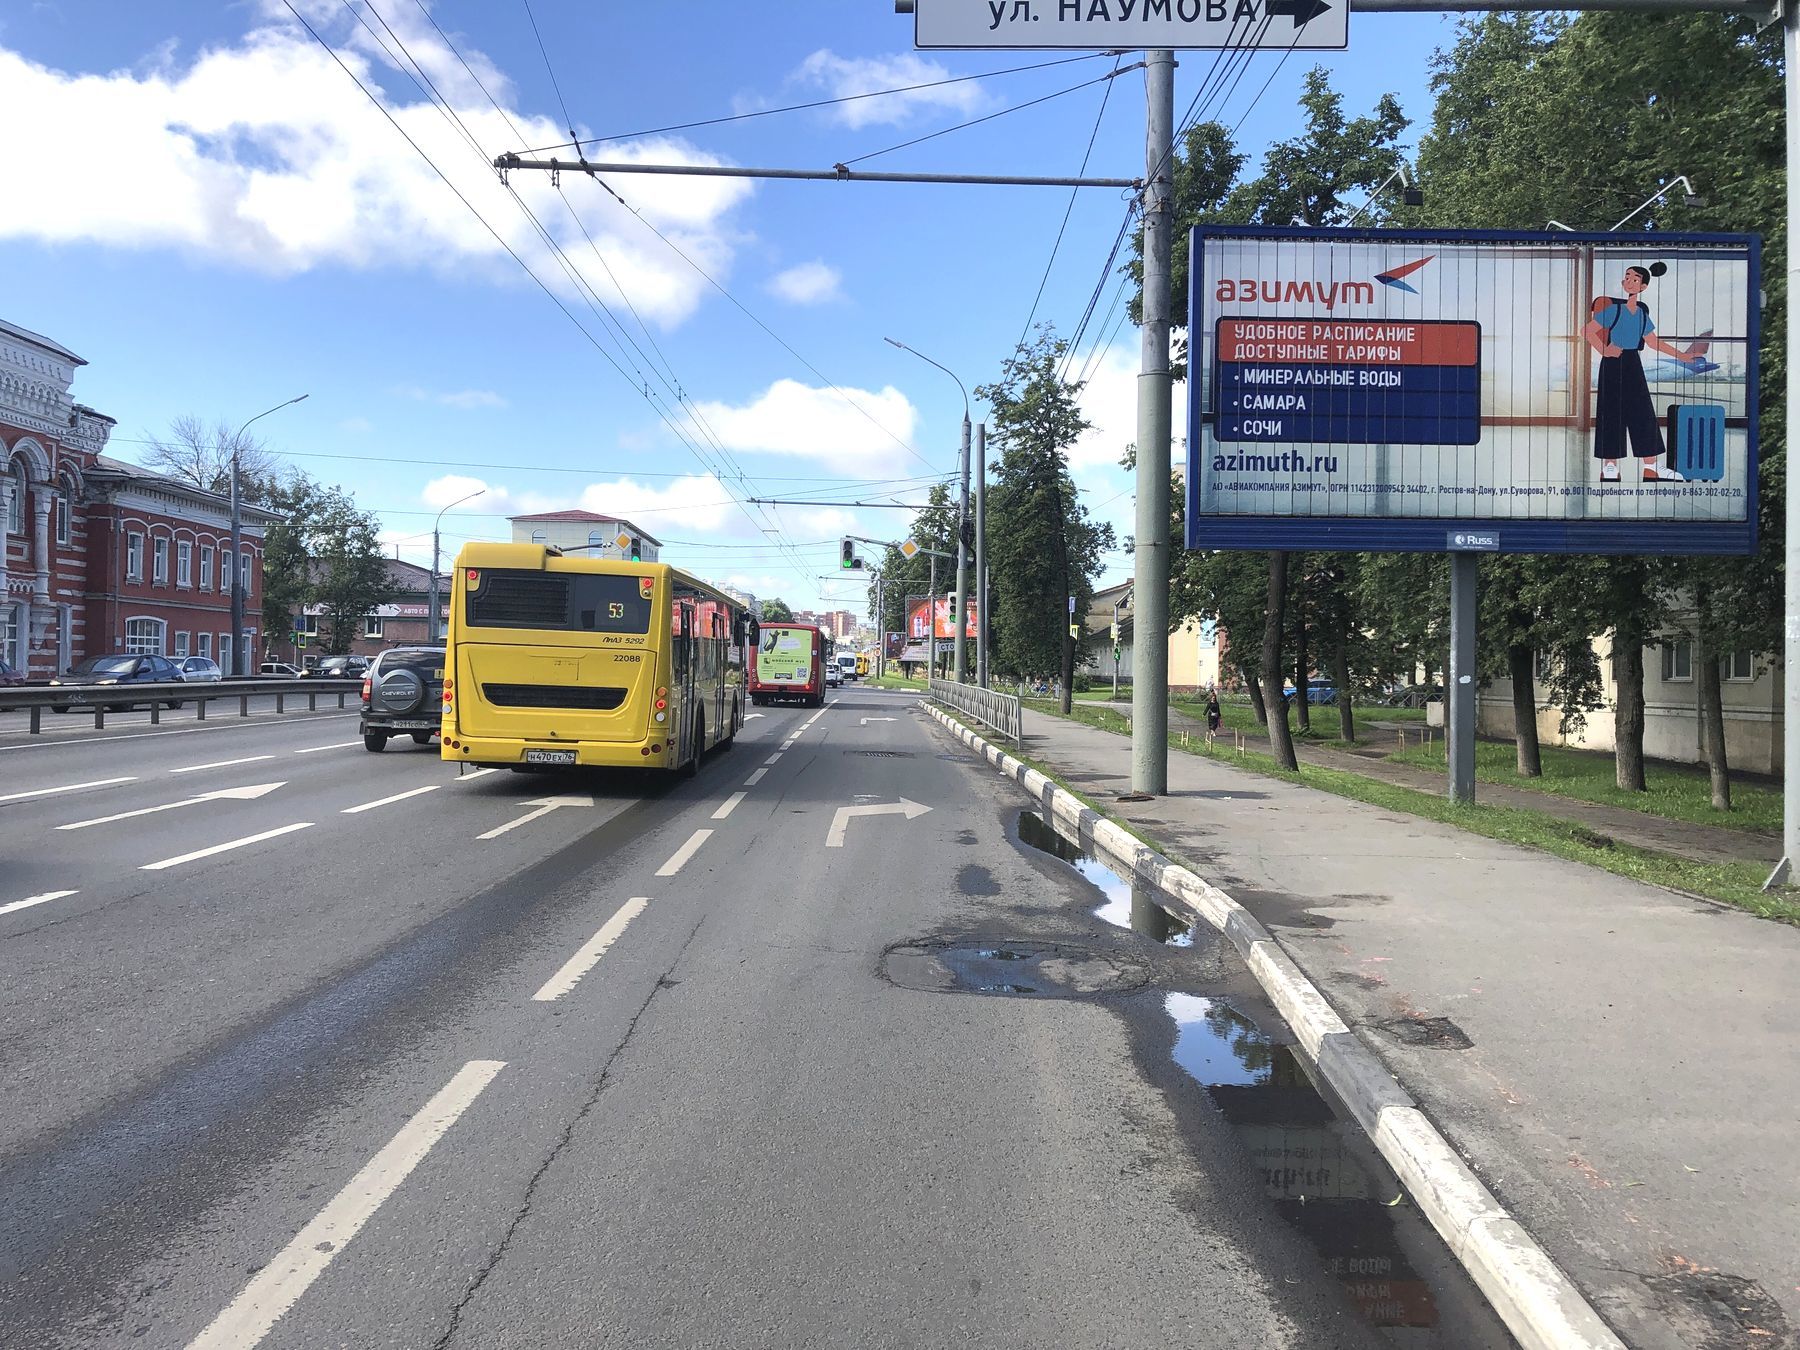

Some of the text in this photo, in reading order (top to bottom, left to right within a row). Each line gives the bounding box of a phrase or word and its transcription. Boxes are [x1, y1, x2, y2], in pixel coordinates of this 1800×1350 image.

[988, 0, 1257, 30] ул. НАУМОВА
[1216, 279, 1374, 310] азимут
[1235, 324, 1415, 342] УДОБНОЕ РАСПИСАНИЕ
[1234, 344, 1401, 360] ДОСТУПНЫЕ ТАРИФЫ
[1244, 368, 1401, 388] МИНЕРАЛЬНЫЕ ВОДЫ
[1243, 394, 1306, 410] САМАРА
[1243, 420, 1282, 436] СОЧИ
[1212, 449, 1338, 472] azimuth.ru
[1212, 482, 1222, 490] АО
[1330, 484, 1348, 492] ОГРН
[1588, 487, 1633, 497] Подробности
[1646, 487, 1681, 497] телефону
[1467, 536, 1492, 544] Russ
[608, 603, 624, 618] 53
